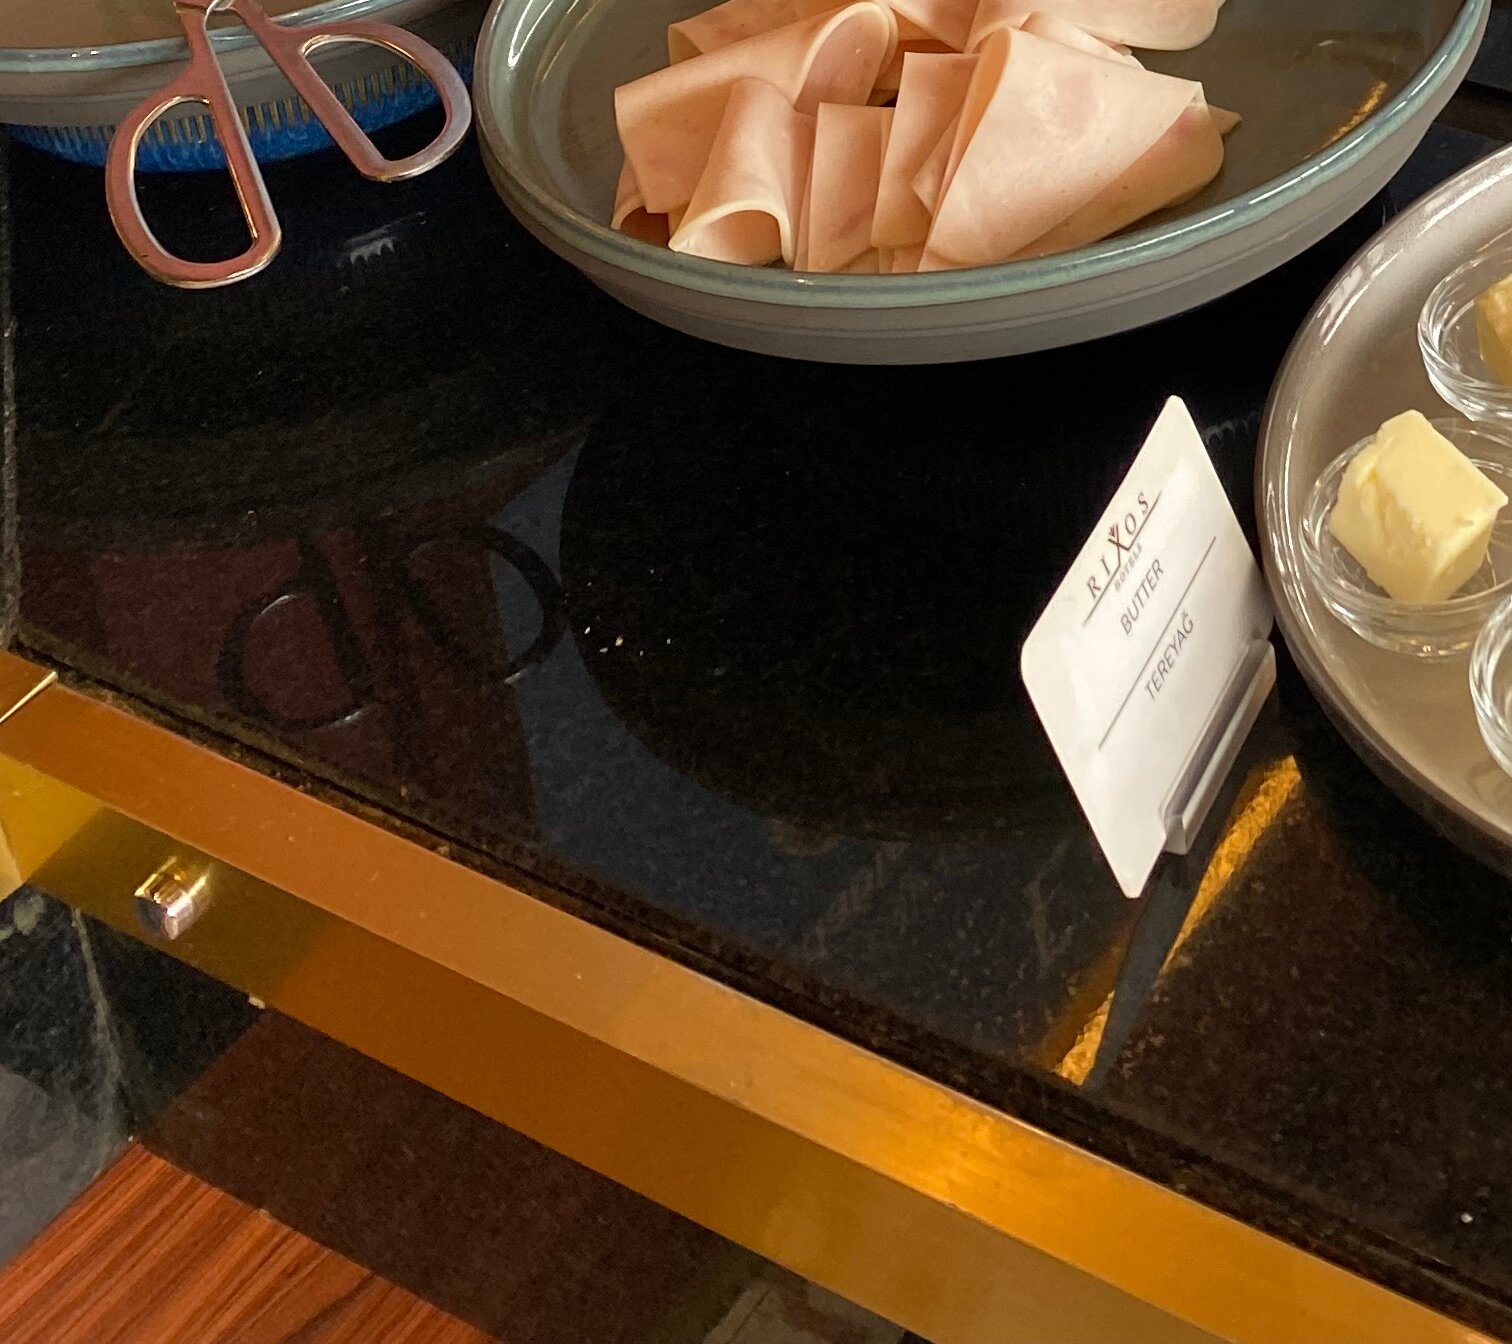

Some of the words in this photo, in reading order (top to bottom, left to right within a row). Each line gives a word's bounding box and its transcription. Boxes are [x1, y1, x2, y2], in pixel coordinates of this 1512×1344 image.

[1086, 491, 1150, 600] RIXOS
[1120, 558, 1164, 635] BUTTER
[1144, 610, 1195, 701] TEREYAĞ
